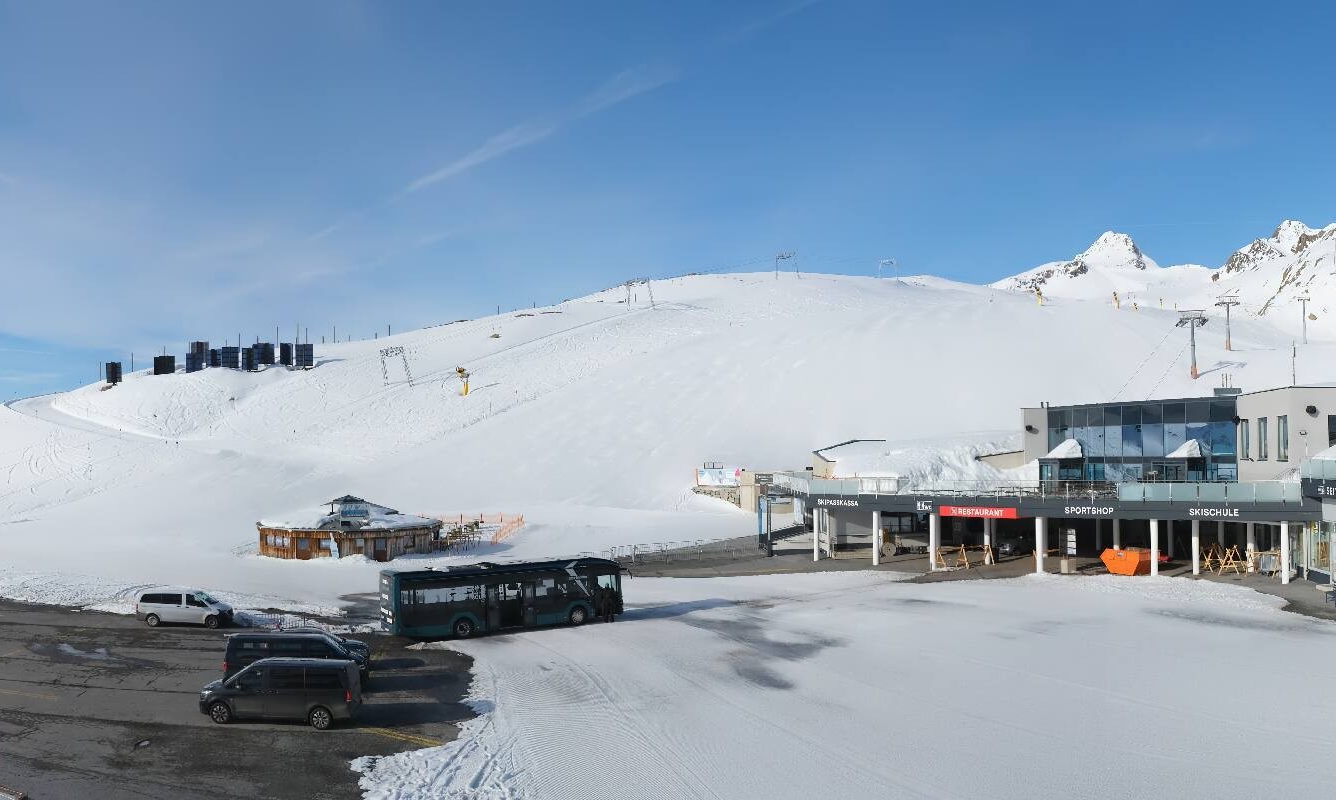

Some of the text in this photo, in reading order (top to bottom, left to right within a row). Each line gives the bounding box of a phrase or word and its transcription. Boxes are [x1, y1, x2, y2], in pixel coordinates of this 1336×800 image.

[817, 498, 859, 507] SKIPASSKASSA
[957, 507, 1004, 517] RESTAURANT
[1064, 506, 1114, 515] SPORTSHOP
[1189, 508, 1240, 517] SKISCHULE
